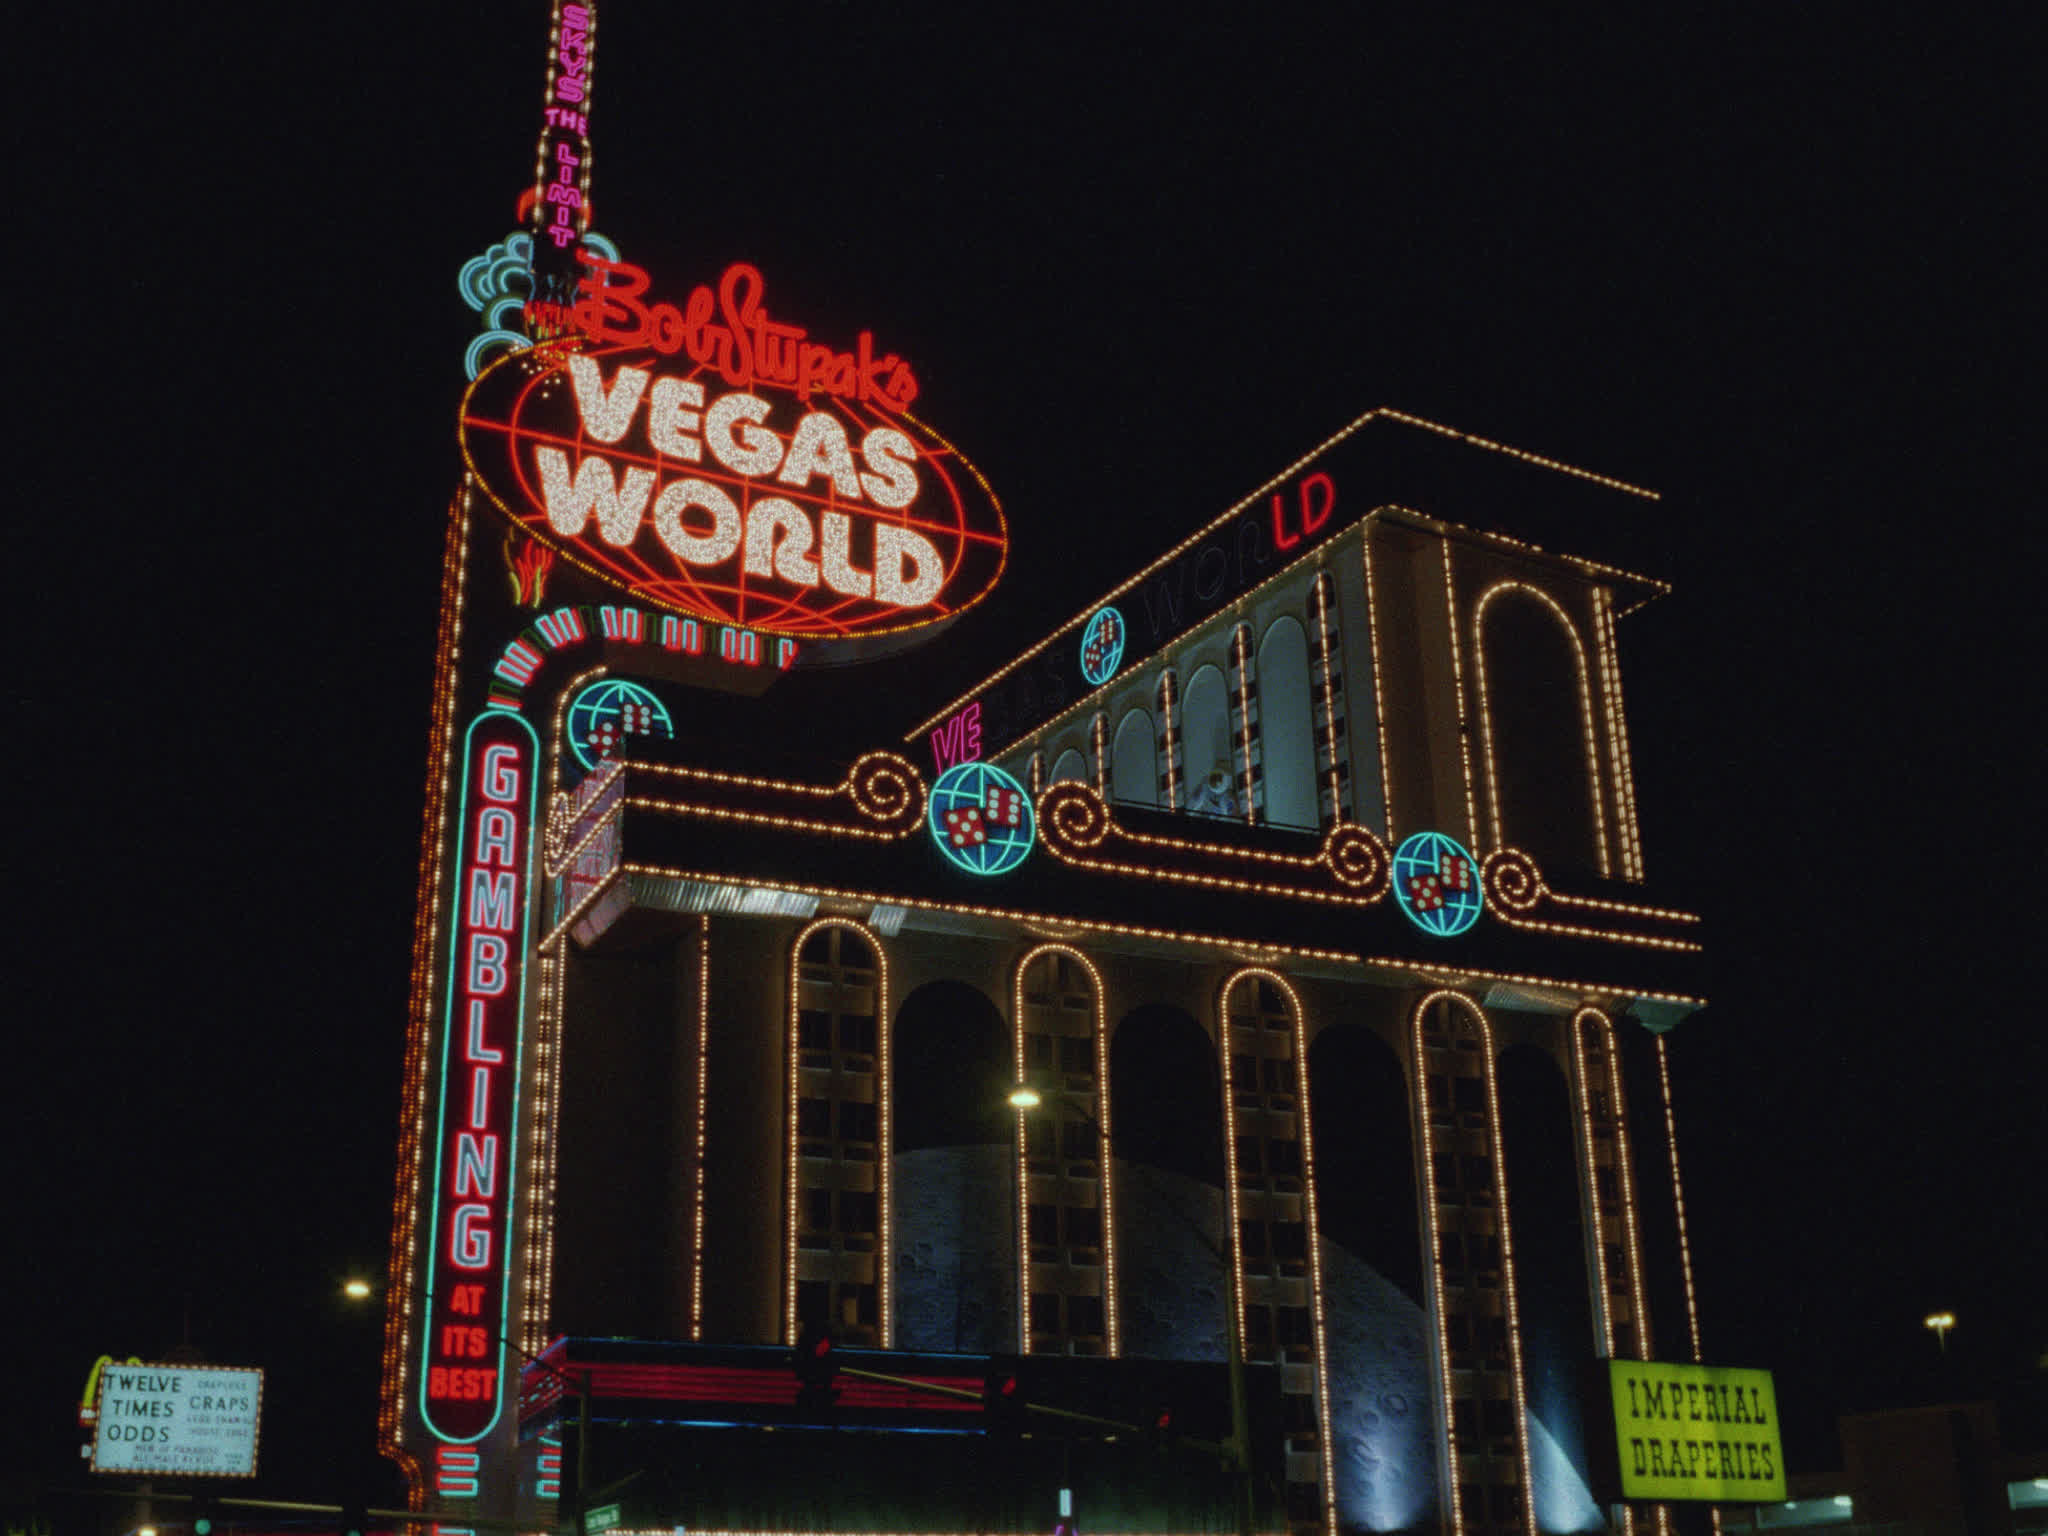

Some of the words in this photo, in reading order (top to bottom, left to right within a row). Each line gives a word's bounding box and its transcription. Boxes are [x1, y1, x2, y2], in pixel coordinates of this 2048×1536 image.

[545, 108, 588, 136] THE
[547, 143, 582, 247] LIMIT
[573, 247, 724, 366] Bob
[568, 354, 920, 510] VEGAS
[535, 445, 945, 607] WORLD
[450, 743, 519, 1269] GAMBLING
[449, 1286, 485, 1316] AT
[442, 1325, 489, 1358] ITS
[104, 1375, 182, 1393] TWELVE
[429, 1366, 498, 1402] BEST
[1628, 1379, 1766, 1424] IMPERIAL
[112, 1399, 174, 1418] TIMES
[190, 1395, 249, 1412] CRAPS
[107, 1424, 169, 1443] ODDS
[1631, 1438, 1774, 1480] DRAPERIES
